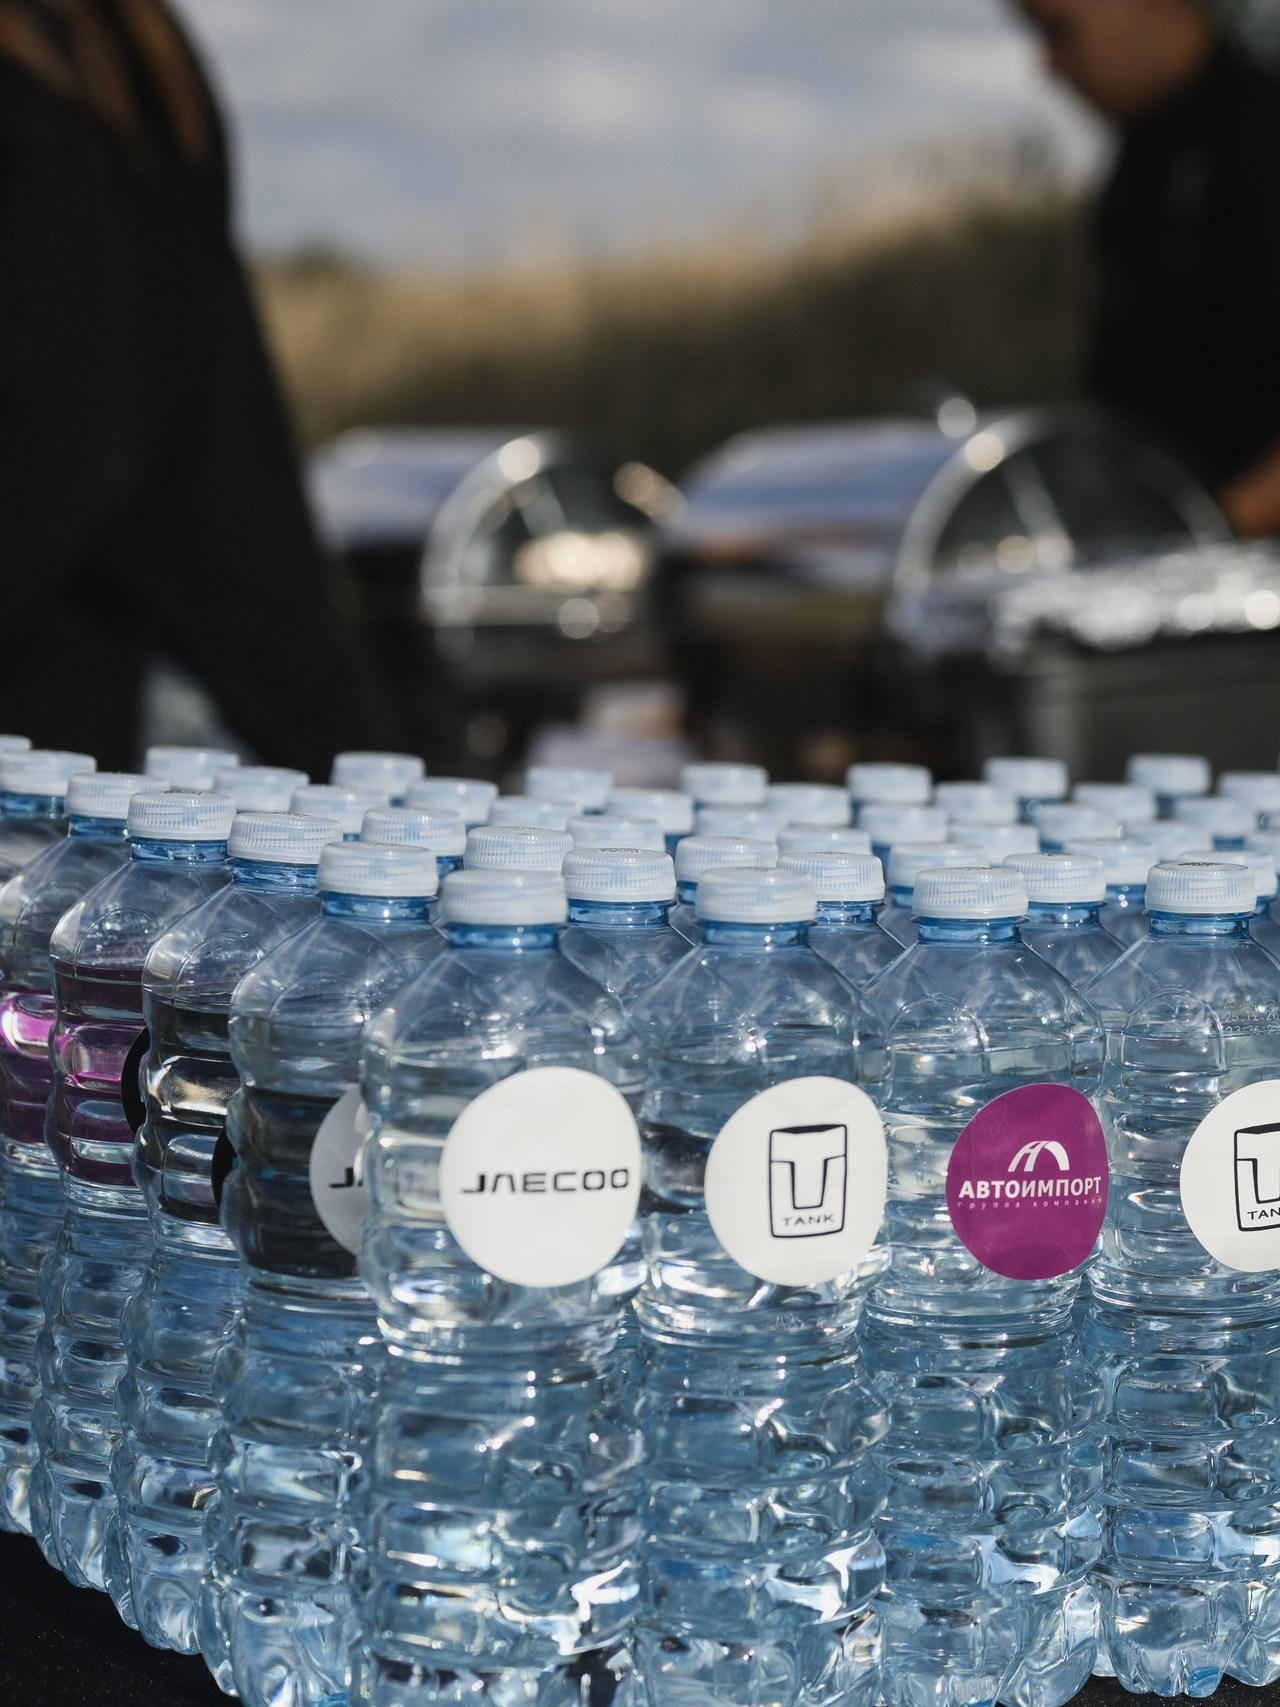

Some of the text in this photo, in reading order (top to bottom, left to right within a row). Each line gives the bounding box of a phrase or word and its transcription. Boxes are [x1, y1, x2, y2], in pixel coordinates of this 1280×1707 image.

[460, 1168, 630, 1195] JAECOO
[957, 1176, 1102, 1199] АВТОИМПОРТ
[781, 1212, 836, 1227] TANK
